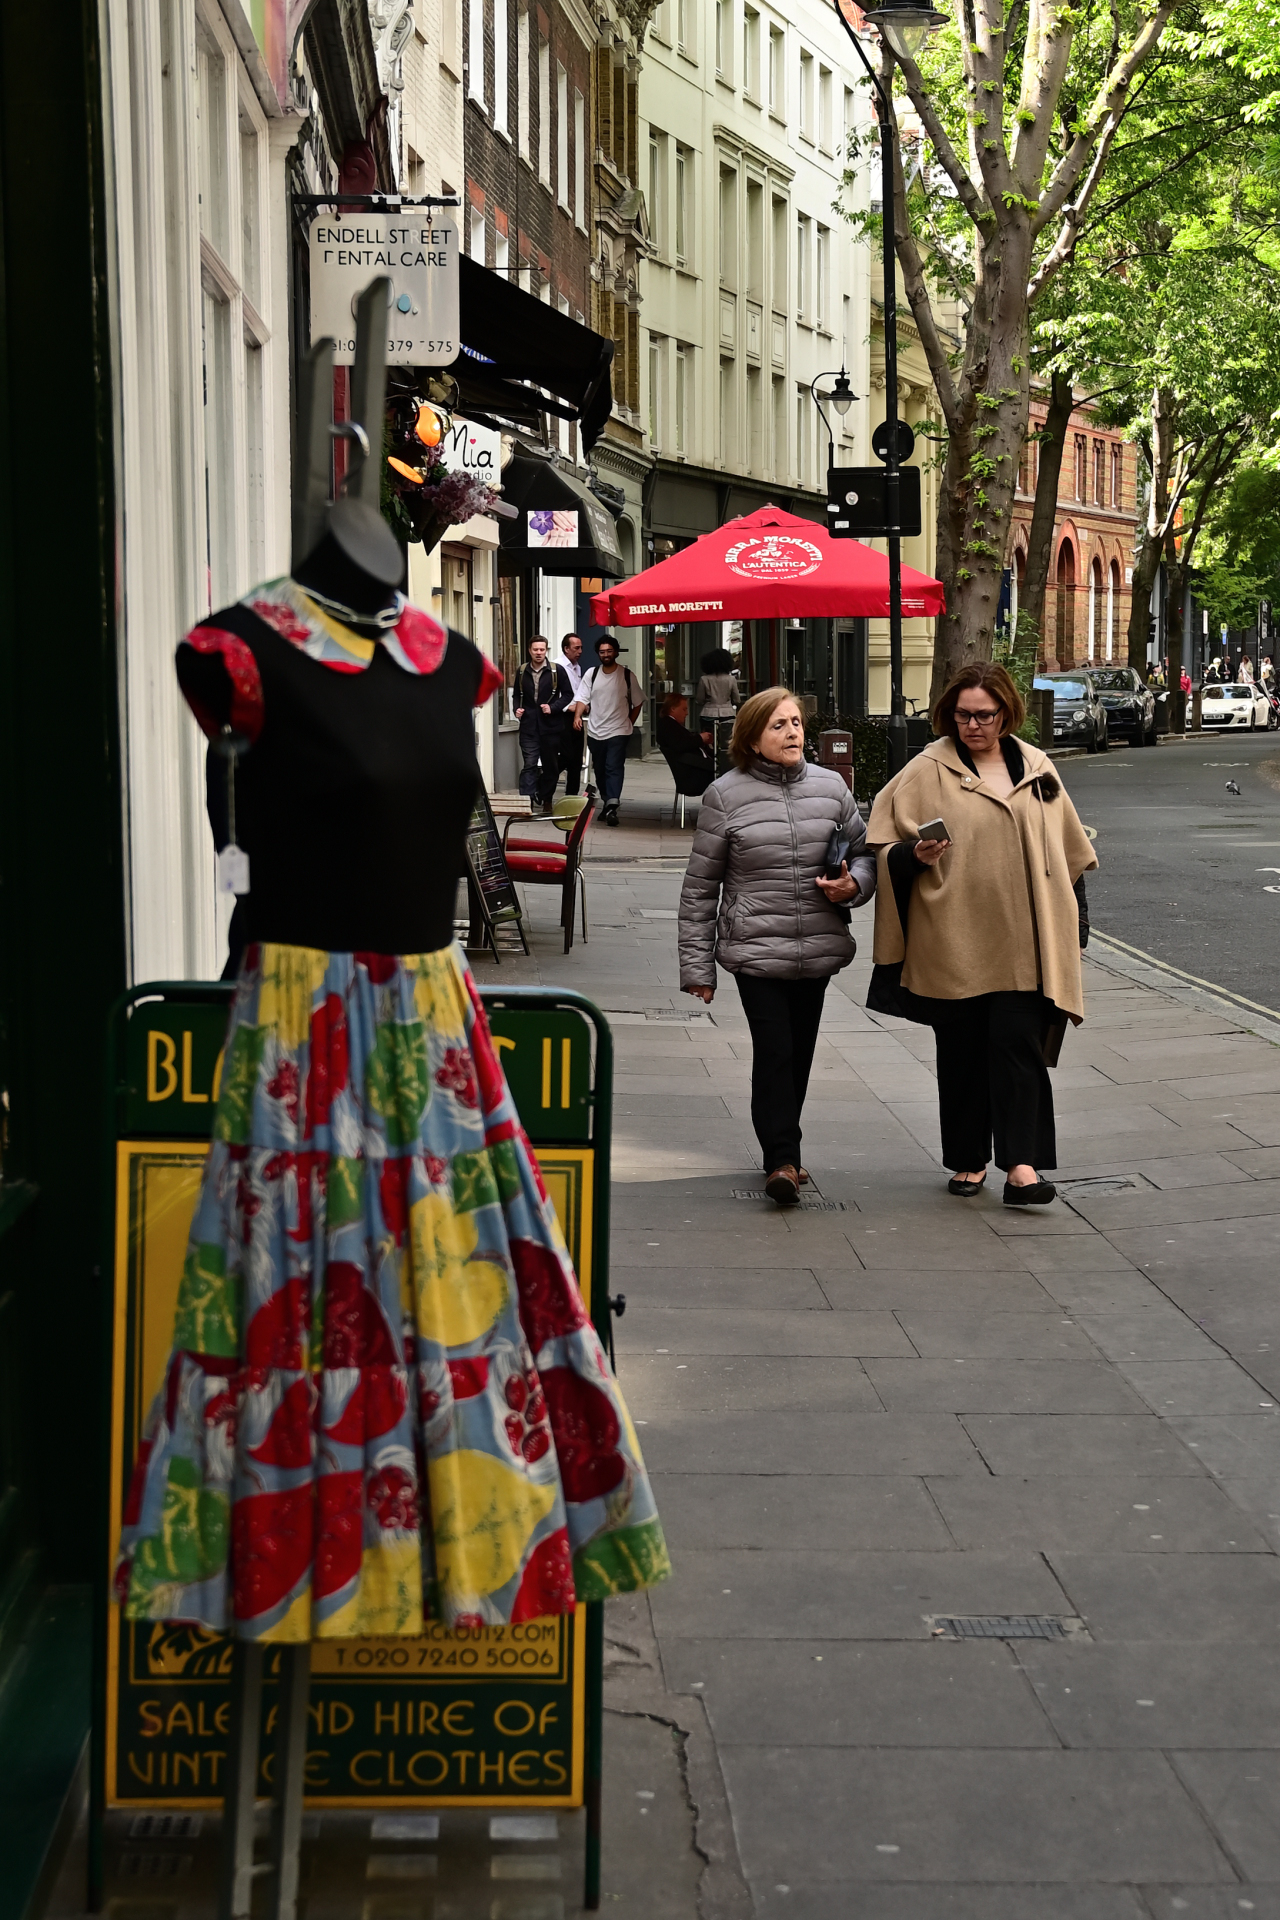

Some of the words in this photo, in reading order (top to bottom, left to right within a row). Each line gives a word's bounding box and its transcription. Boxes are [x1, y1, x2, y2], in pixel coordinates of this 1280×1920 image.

[317, 228, 385, 244] ENDELL
[400, 251, 447, 267] CARE
[724, 538, 762, 563] BIRRA
[763, 536, 823, 561] MORETTI
[742, 561, 807, 569] L'AUTENTICA
[628, 604, 667, 615] BIRRA
[668, 601, 723, 612] MORETTI
[417, 1648, 479, 1667] 7240
[486, 1648, 554, 1667] 5006
[138, 1700, 231, 1737] SALE
[374, 1700, 475, 1736] HIRE
[493, 1699, 559, 1736] OF
[128, 1751, 330, 1786] VINTE
[349, 1749, 567, 1786] CLOTHES
